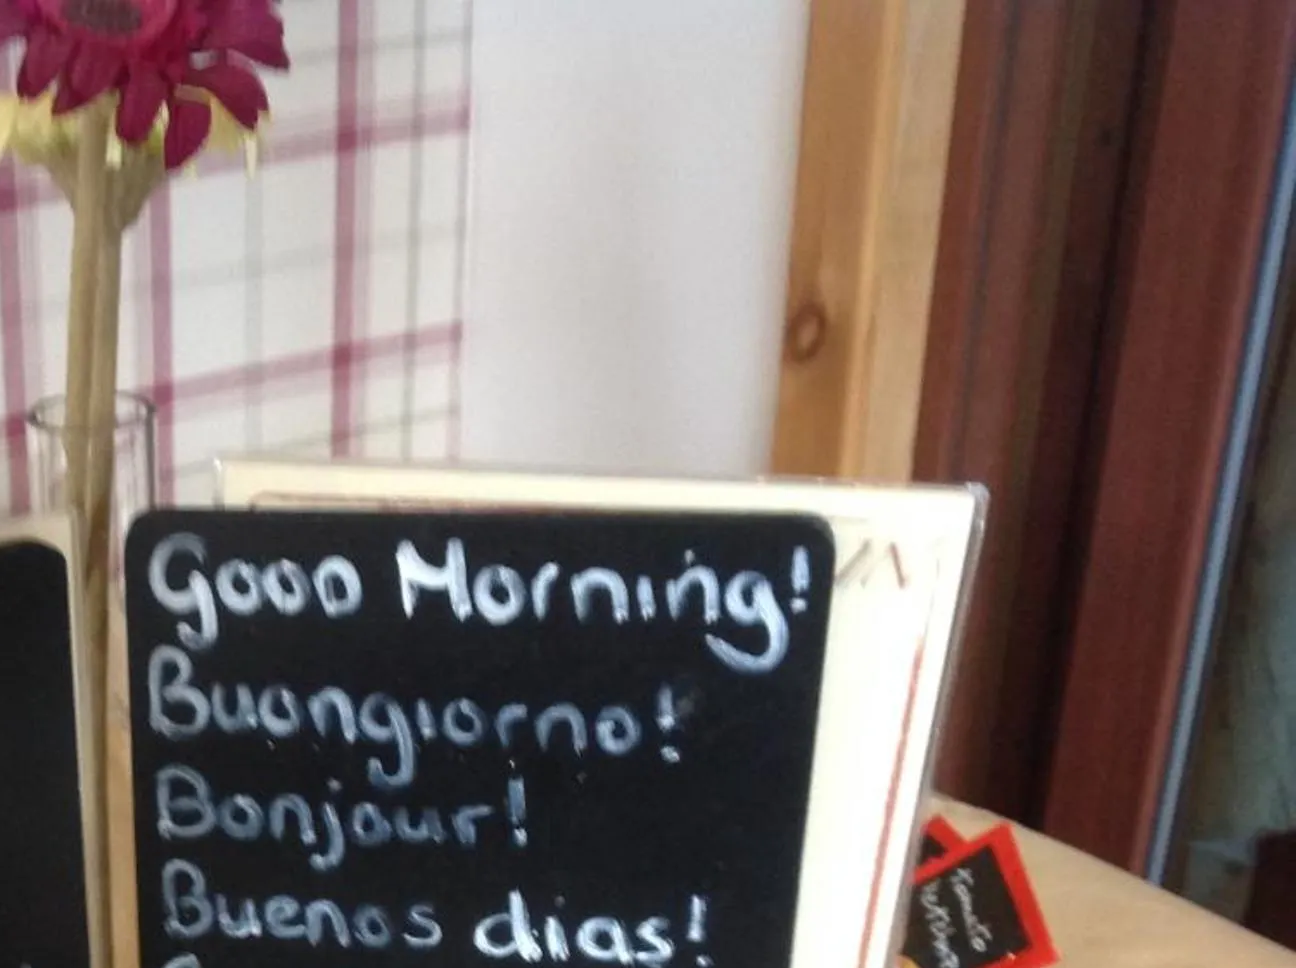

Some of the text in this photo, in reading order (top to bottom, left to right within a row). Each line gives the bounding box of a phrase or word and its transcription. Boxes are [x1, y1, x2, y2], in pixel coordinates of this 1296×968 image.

[395, 538, 811, 675] Morning!
[148, 643, 680, 788] Buongiorno!
[156, 758, 528, 871] Bonjour!
[162, 858, 713, 967] Buenos dias!
